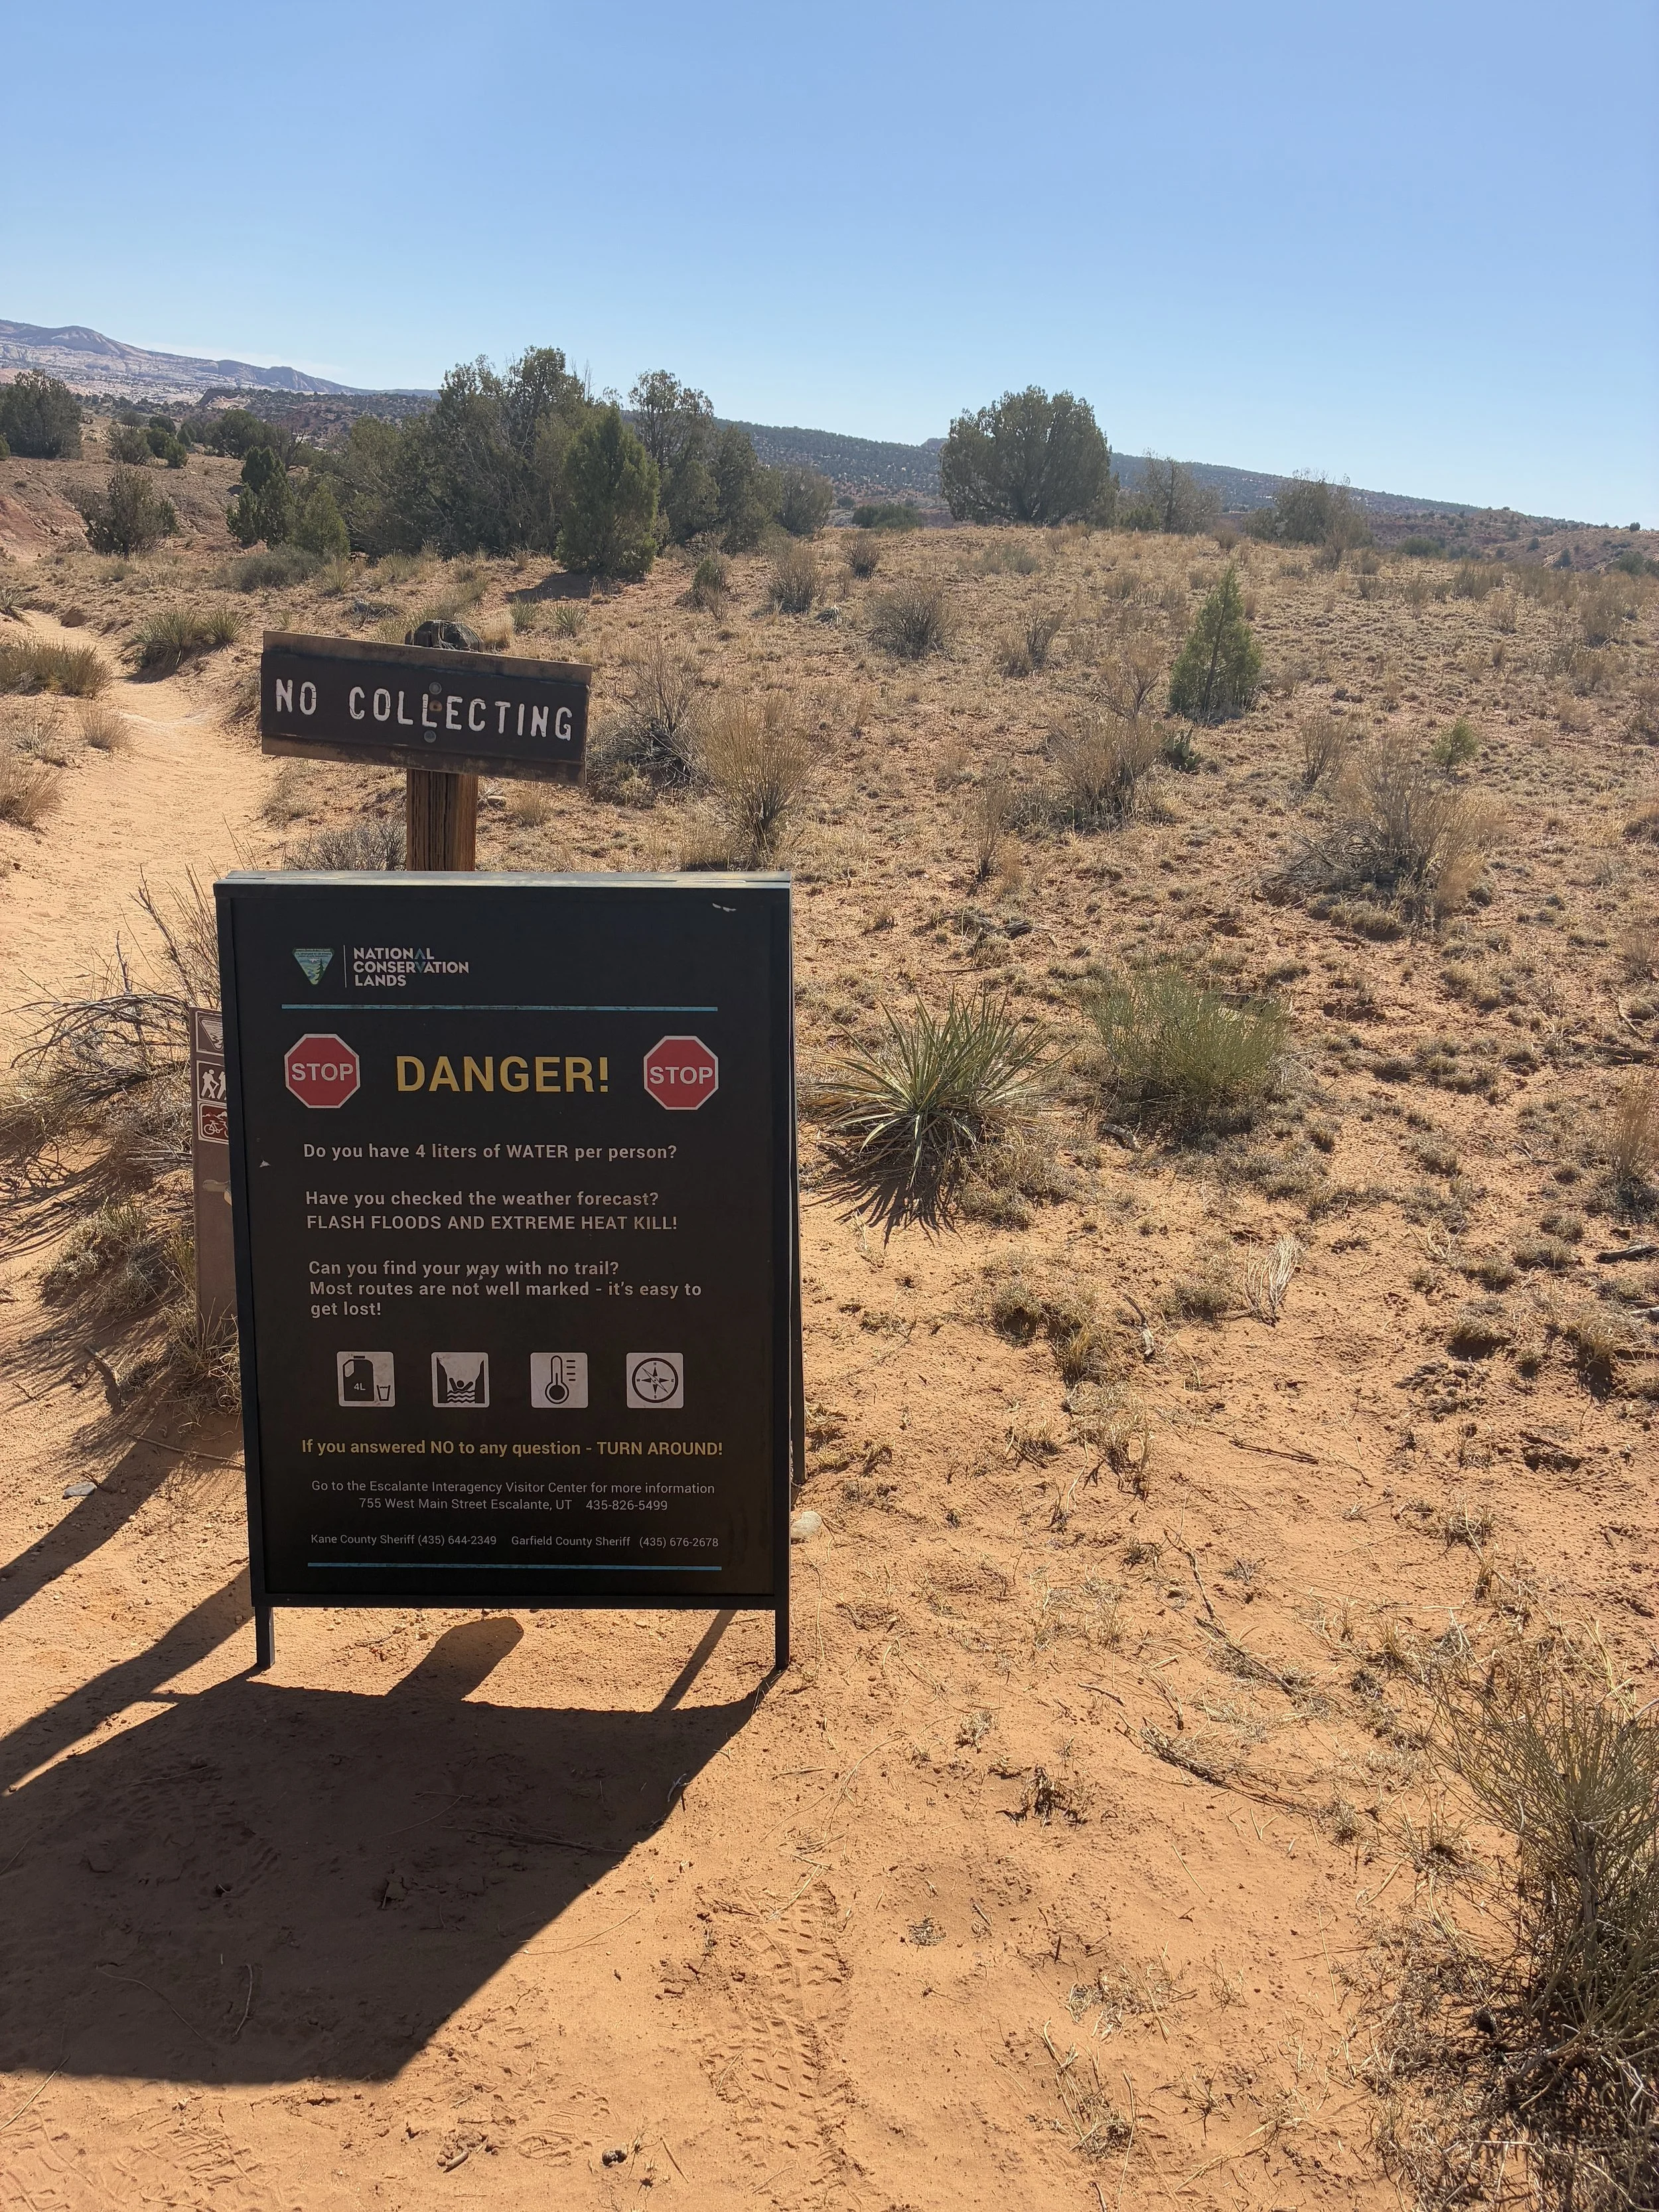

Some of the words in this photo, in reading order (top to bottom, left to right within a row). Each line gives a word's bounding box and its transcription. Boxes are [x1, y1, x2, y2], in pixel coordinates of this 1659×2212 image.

[275, 678, 317, 716] NO
[348, 686, 573, 741] COLLECTING
[353, 947, 435, 960] NATIONAL
[353, 960, 469, 974] CONSERVATION
[354, 974, 407, 987] LANDS
[291, 1063, 354, 1081] STOP
[396, 1055, 609, 1092] DANGER!
[650, 1066, 713, 1085] STOP
[303, 1143, 326, 1157] Do
[331, 1147, 362, 1161] you
[369, 1143, 409, 1158] have
[415, 1144, 426, 1158] 4
[432, 1143, 476, 1158] liters
[483, 1143, 501, 1158] of
[506, 1144, 569, 1158] WATER
[575, 1147, 603, 1162] per
[609, 1145, 677, 1162] person?
[306, 1191, 348, 1205] Have
[354, 1194, 385, 1209] you
[391, 1191, 463, 1205] checked
[468, 1191, 496, 1205] the
[502, 1191, 571, 1205] weather
[577, 1191, 659, 1206] forecast?
[307, 1215, 364, 1229] FLASH
[371, 1215, 441, 1230] FLOODS
[447, 1216, 484, 1229] AND
[491, 1216, 575, 1230] EXTREME
[581, 1216, 628, 1230] HEAT
[634, 1216, 677, 1230] KILL!
[309, 1260, 341, 1274] Can
[346, 1264, 377, 1278] you
[383, 1260, 417, 1275] find
[422, 1264, 461, 1278] your
[466, 1264, 500, 1279] way
[505, 1260, 541, 1275] with
[548, 1264, 569, 1275] no
[574, 1260, 619, 1275] trail?
[310, 1281, 353, 1295] Most
[358, 1282, 413, 1295] routes
[419, 1285, 446, 1295] are
[452, 1283, 480, 1295] not
[485, 1281, 520, 1295] well
[526, 1281, 589, 1295] marked
[640, 1284, 679, 1299] easy
[684, 1283, 701, 1296] to
[311, 1303, 338, 1319] get
[344, 1301, 381, 1315] lost!
[354, 1382, 366, 1391] 4L
[302, 1438, 313, 1453] If
[317, 1442, 346, 1456] you
[350, 1439, 425, 1453] answered
[431, 1440, 454, 1454] NO
[458, 1441, 475, 1454] to
[479, 1443, 508, 1457] any
[512, 1440, 581, 1457] question
[597, 1441, 642, 1455] TURN
[647, 1441, 723, 1455] AROUND!
[312, 1480, 328, 1491] Go
[331, 1481, 344, 1491] to
[346, 1480, 366, 1491] the
[370, 1480, 429, 1492] Escalante
[432, 1481, 502, 1495] Interagency
[505, 1481, 545, 1493] Visitor
[548, 1482, 588, 1493] Center
[591, 1481, 608, 1493] for
[611, 1485, 642, 1493] more
[645, 1482, 715, 1494] information
[358, 1498, 382, 1509] 755
[384, 1498, 415, 1509] West
[418, 1498, 448, 1509] Main
[451, 1499, 487, 1509] Street
[491, 1499, 552, 1511] Escalante,
[555, 1499, 573, 1510] UT
[585, 1499, 668, 1511] 435-826-5499
[311, 1534, 338, 1544] Kane
[340, 1534, 377, 1546] County
[380, 1534, 415, 1544] Sheriff
[417, 1534, 445, 1546] (435)
[448, 1535, 496, 1545] 644-2349
[511, 1535, 552, 1546] Garfield
[555, 1536, 593, 1548] County
[595, 1536, 631, 1546] Sheriff
[639, 1536, 666, 1549] (435)
[670, 1537, 719, 1547] 676-2678
